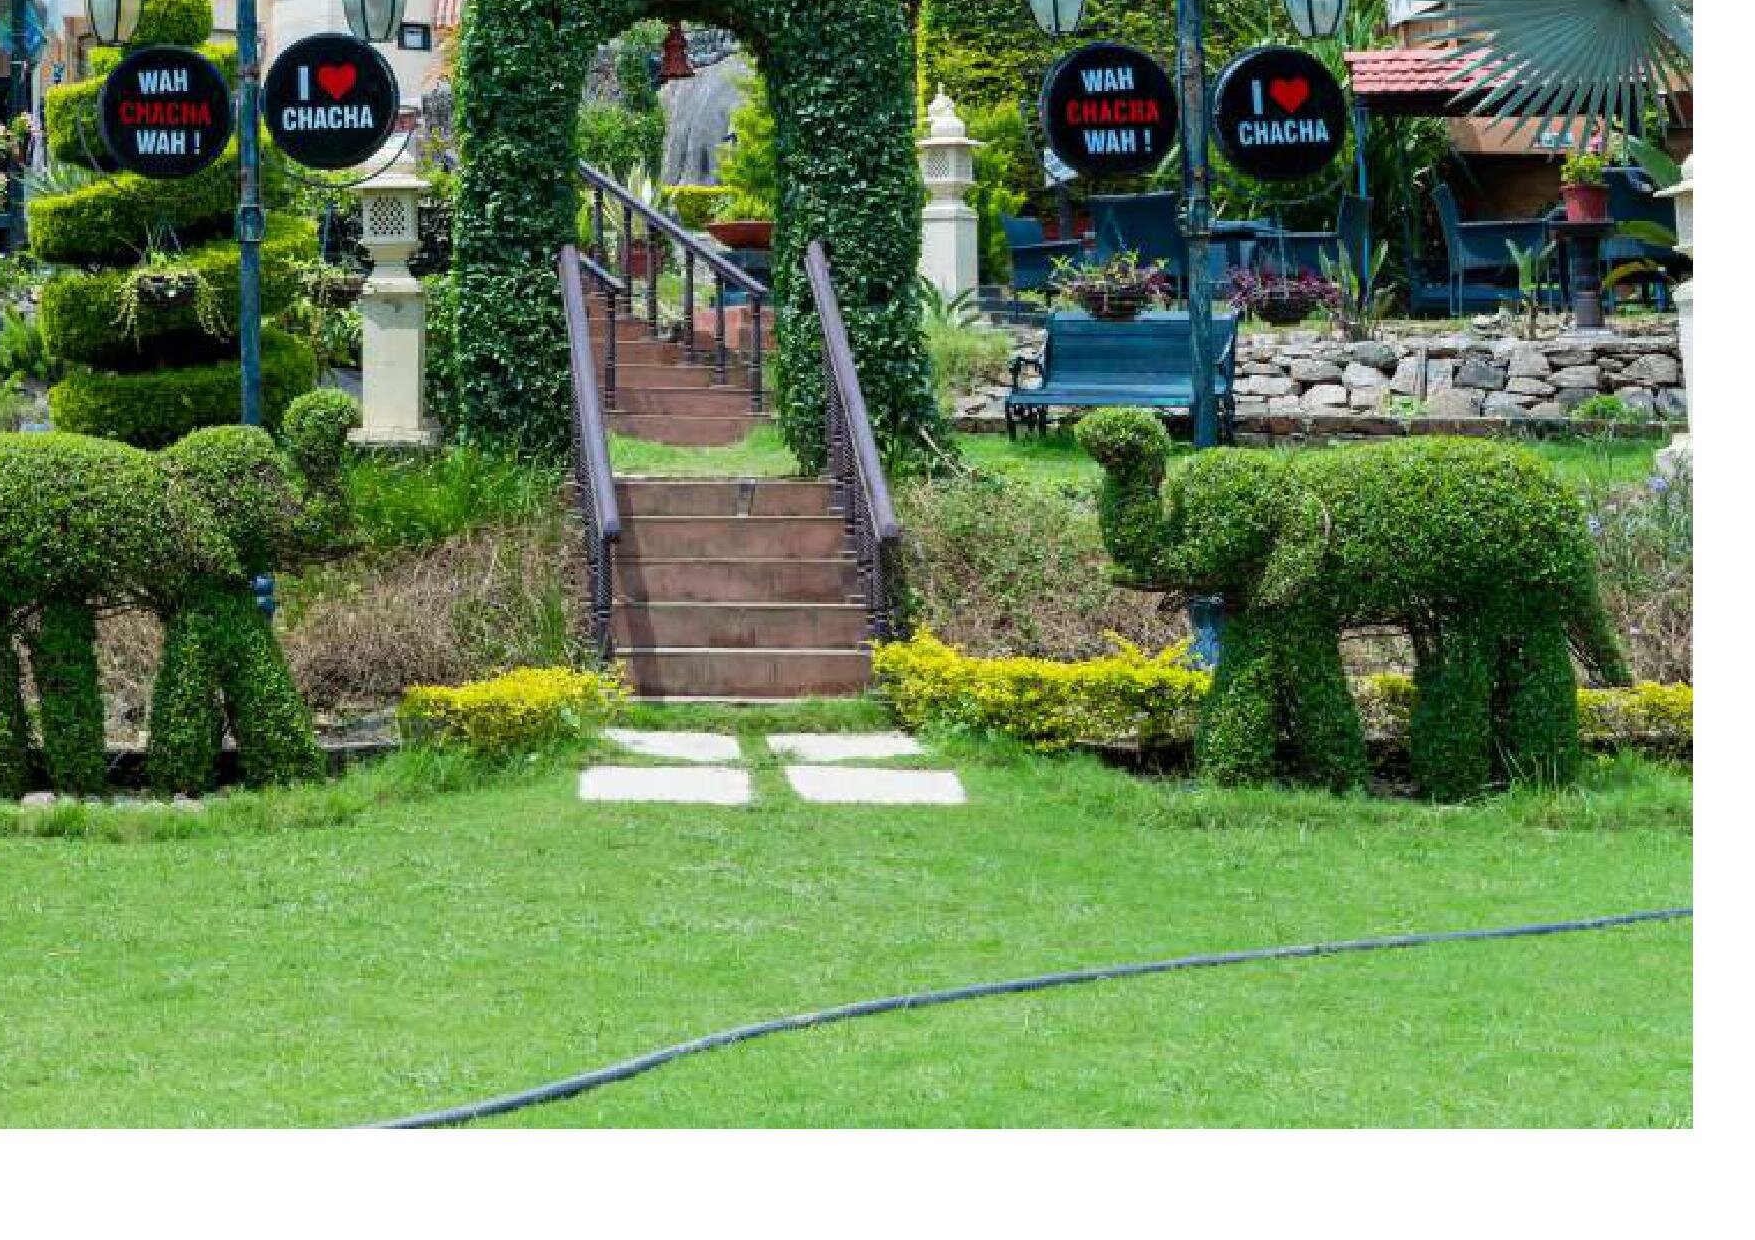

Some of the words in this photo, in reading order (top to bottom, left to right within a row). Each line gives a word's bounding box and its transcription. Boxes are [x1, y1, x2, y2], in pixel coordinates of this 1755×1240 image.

[138, 68, 188, 95] WAH
[298, 66, 308, 100] I
[1081, 67, 1134, 93] WAH
[1252, 80, 1263, 114] I
[119, 100, 212, 126] CHACHA
[283, 105, 373, 130] CHACHA
[1066, 99, 1160, 126] CHACHA
[136, 130, 185, 155] WAH
[194, 130, 200, 154] !
[1085, 129, 1136, 154] WAH
[1144, 129, 1151, 150] !
[1238, 118, 1329, 145] CHACHA
